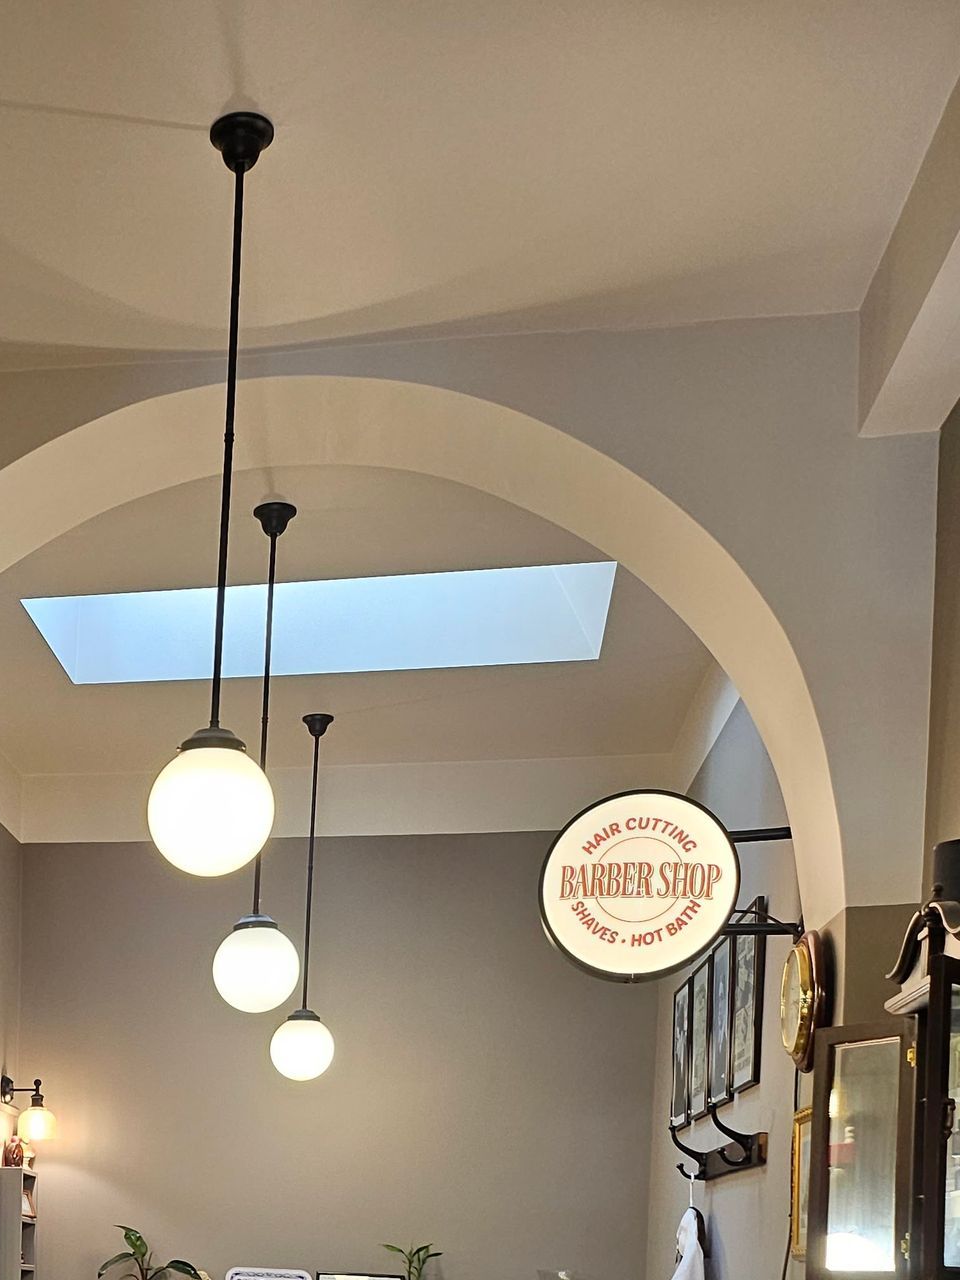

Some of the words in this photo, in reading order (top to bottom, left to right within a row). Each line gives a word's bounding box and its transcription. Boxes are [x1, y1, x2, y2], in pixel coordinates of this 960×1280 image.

[582, 822, 622, 855] HAIR
[626, 817, 698, 853] CUTTING
[560, 861, 654, 900] BARBER
[657, 861, 722, 900] SHOP
[572, 901, 619, 944] SHAVES
[631, 928, 663, 947] HOT
[667, 900, 702, 937] BATH
